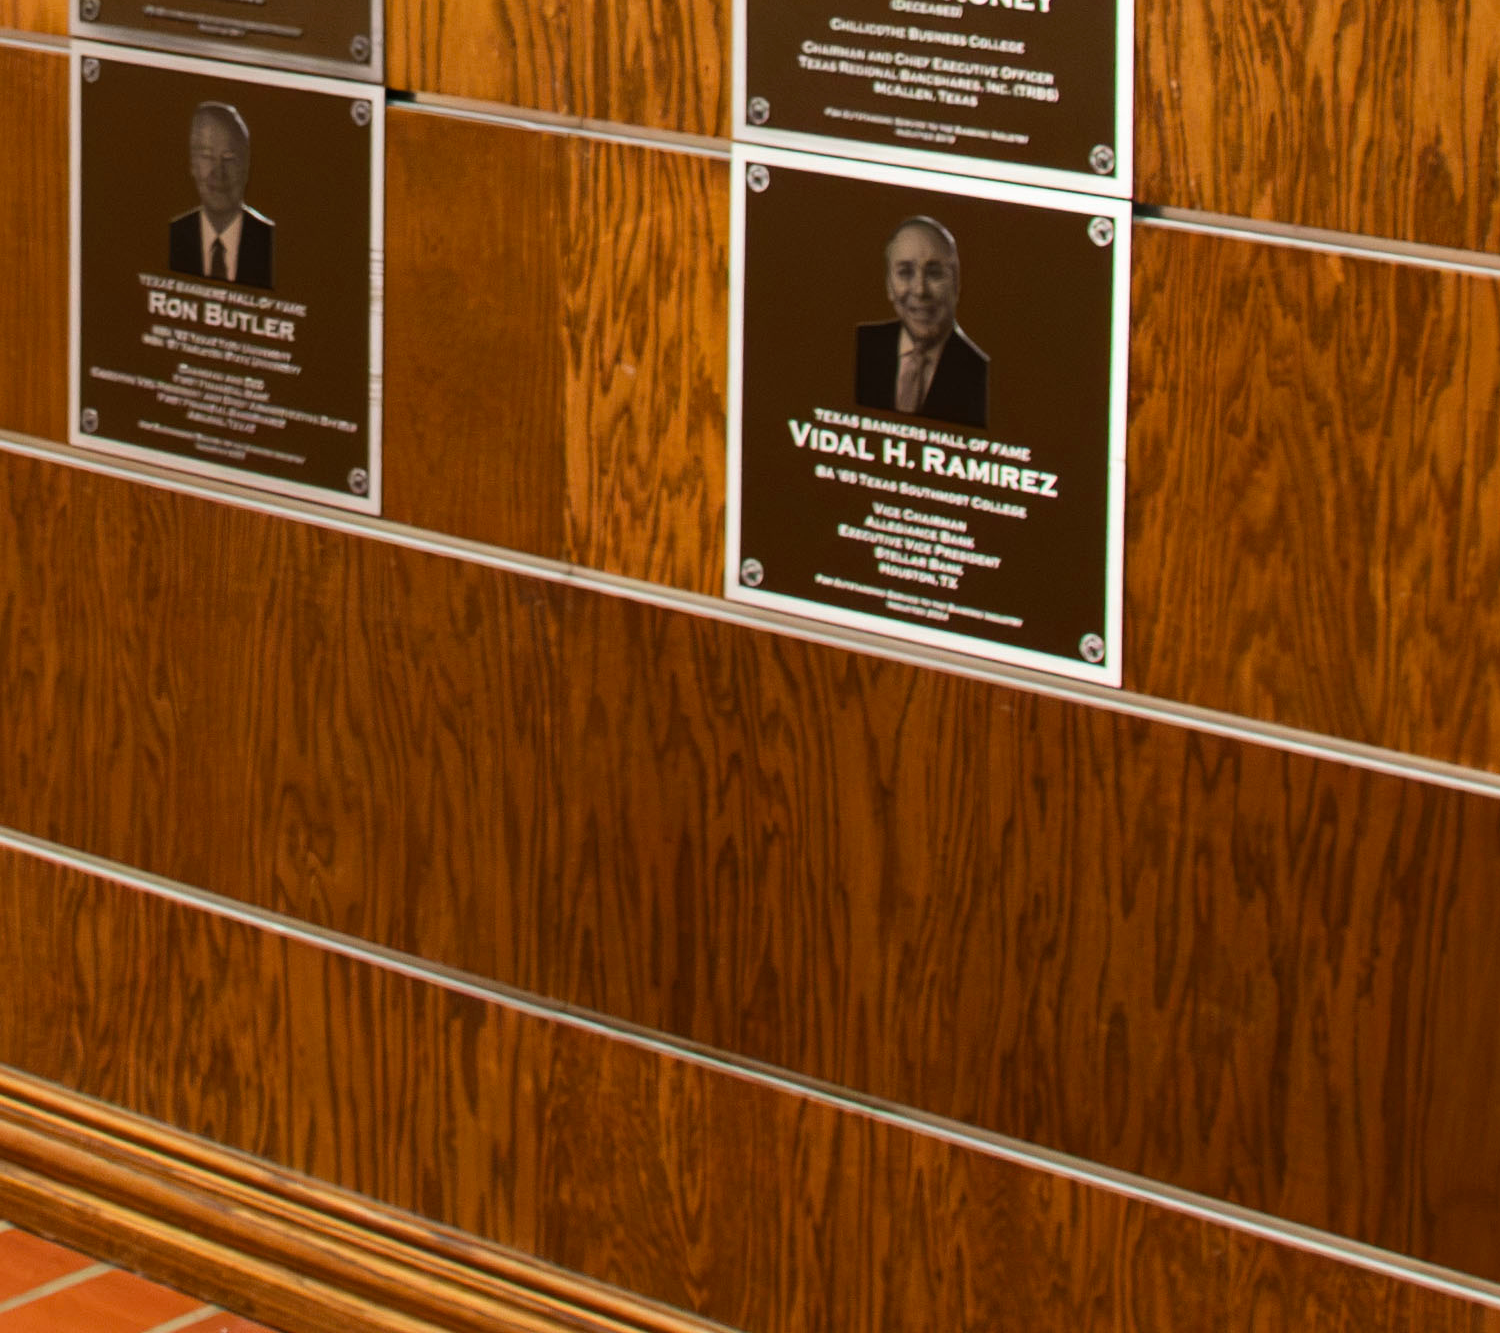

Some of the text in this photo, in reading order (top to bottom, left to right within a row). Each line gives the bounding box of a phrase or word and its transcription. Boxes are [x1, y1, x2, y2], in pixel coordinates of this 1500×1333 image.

[788, 419, 1058, 498] VIDAL H. RAMIREZ
